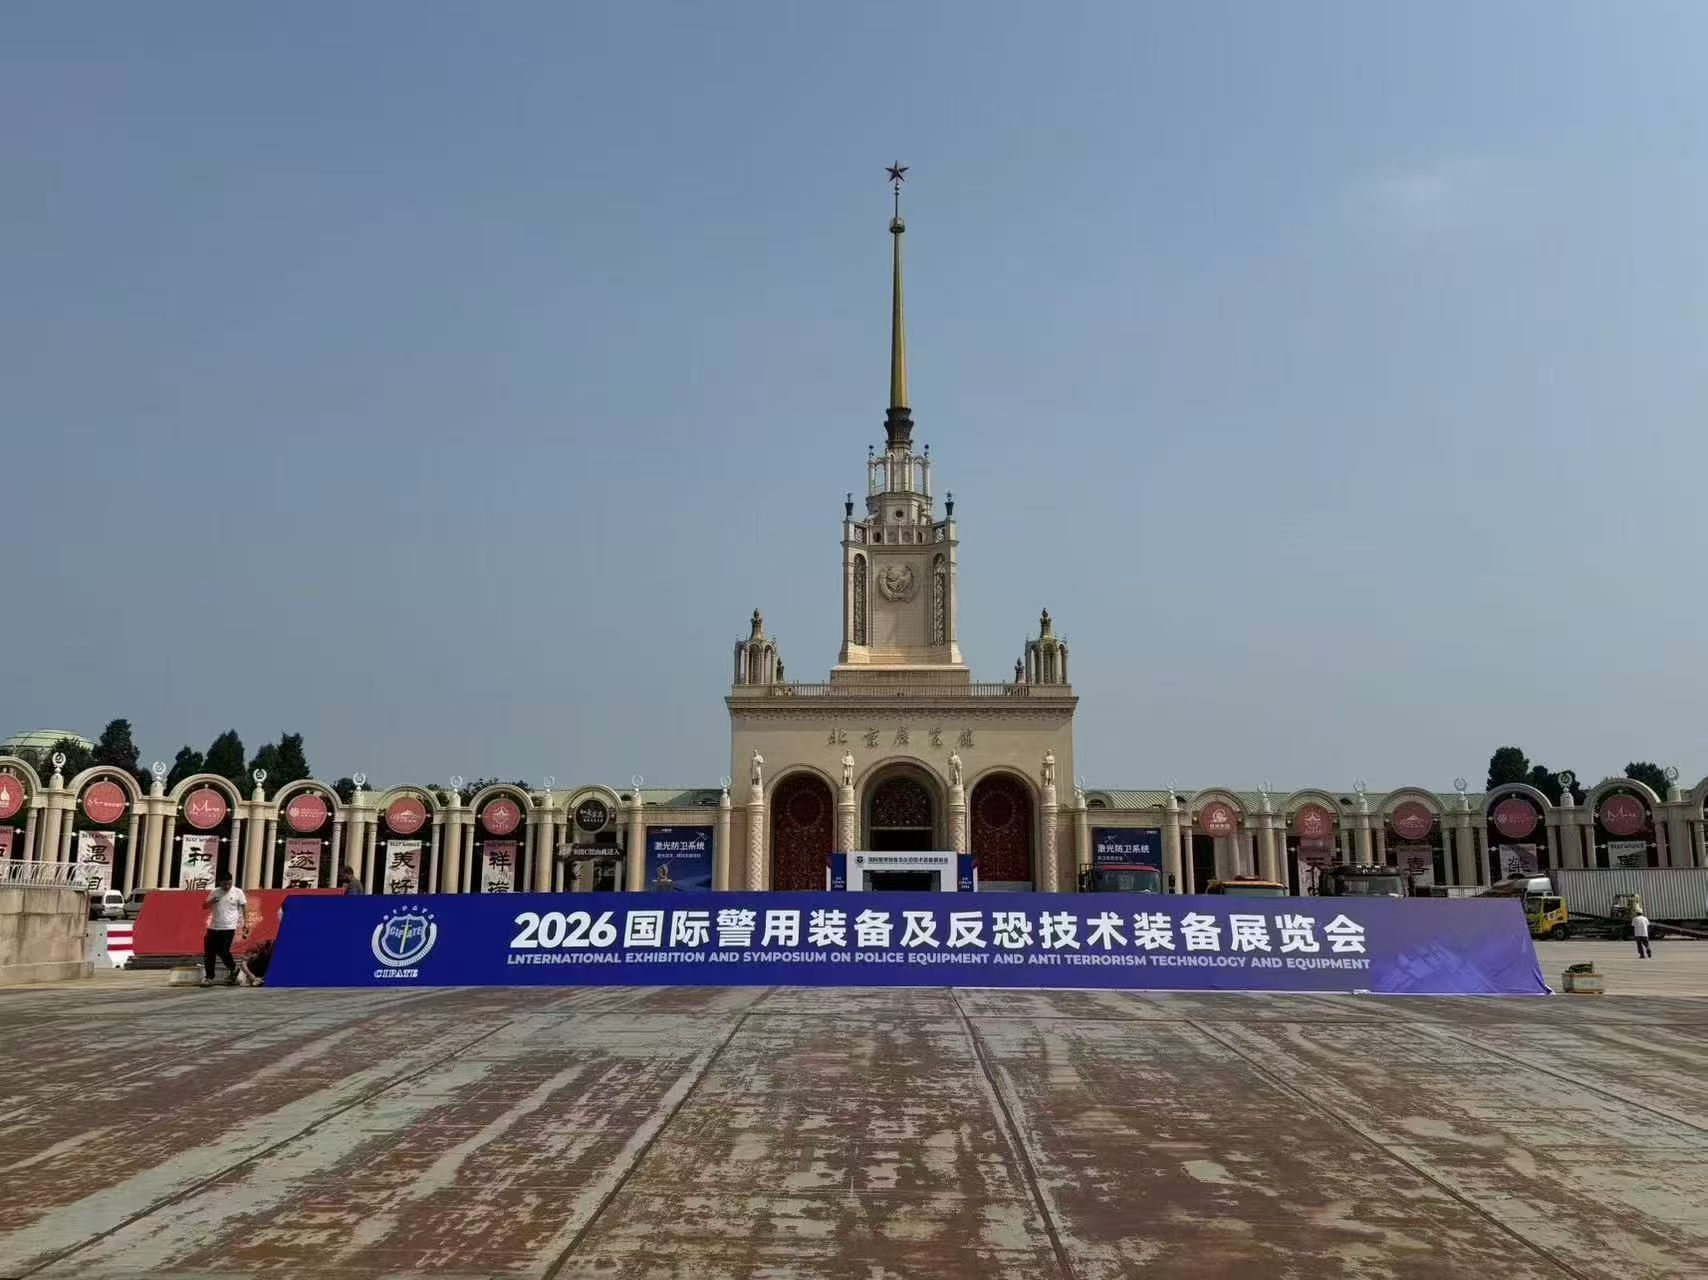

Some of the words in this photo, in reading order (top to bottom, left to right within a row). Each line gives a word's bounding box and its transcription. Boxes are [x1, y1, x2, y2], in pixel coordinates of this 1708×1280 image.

[654, 841, 705, 850] 激光防卫系统
[1097, 844, 1150, 853] 激光防卫系统
[510, 909, 1367, 954] 2026国际警用装备及反恐技术装备展览会
[625, 952, 705, 963] EXHIBITION
[709, 951, 740, 962] AND
[743, 951, 827, 962] SYMPOSIUM
[830, 952, 851, 963] ON
[855, 952, 904, 963] POLICE
[908, 952, 989, 965] EQUIPMENT
[993, 953, 1024, 964] AND
[1028, 953, 1061, 965] ANTI
[1064, 954, 1147, 966] TERRORISM
[1150, 955, 1247, 967] TECHNOLOGY
[1251, 957, 1282, 968] AND
[1287, 957, 1371, 970] EQUIPMENT
